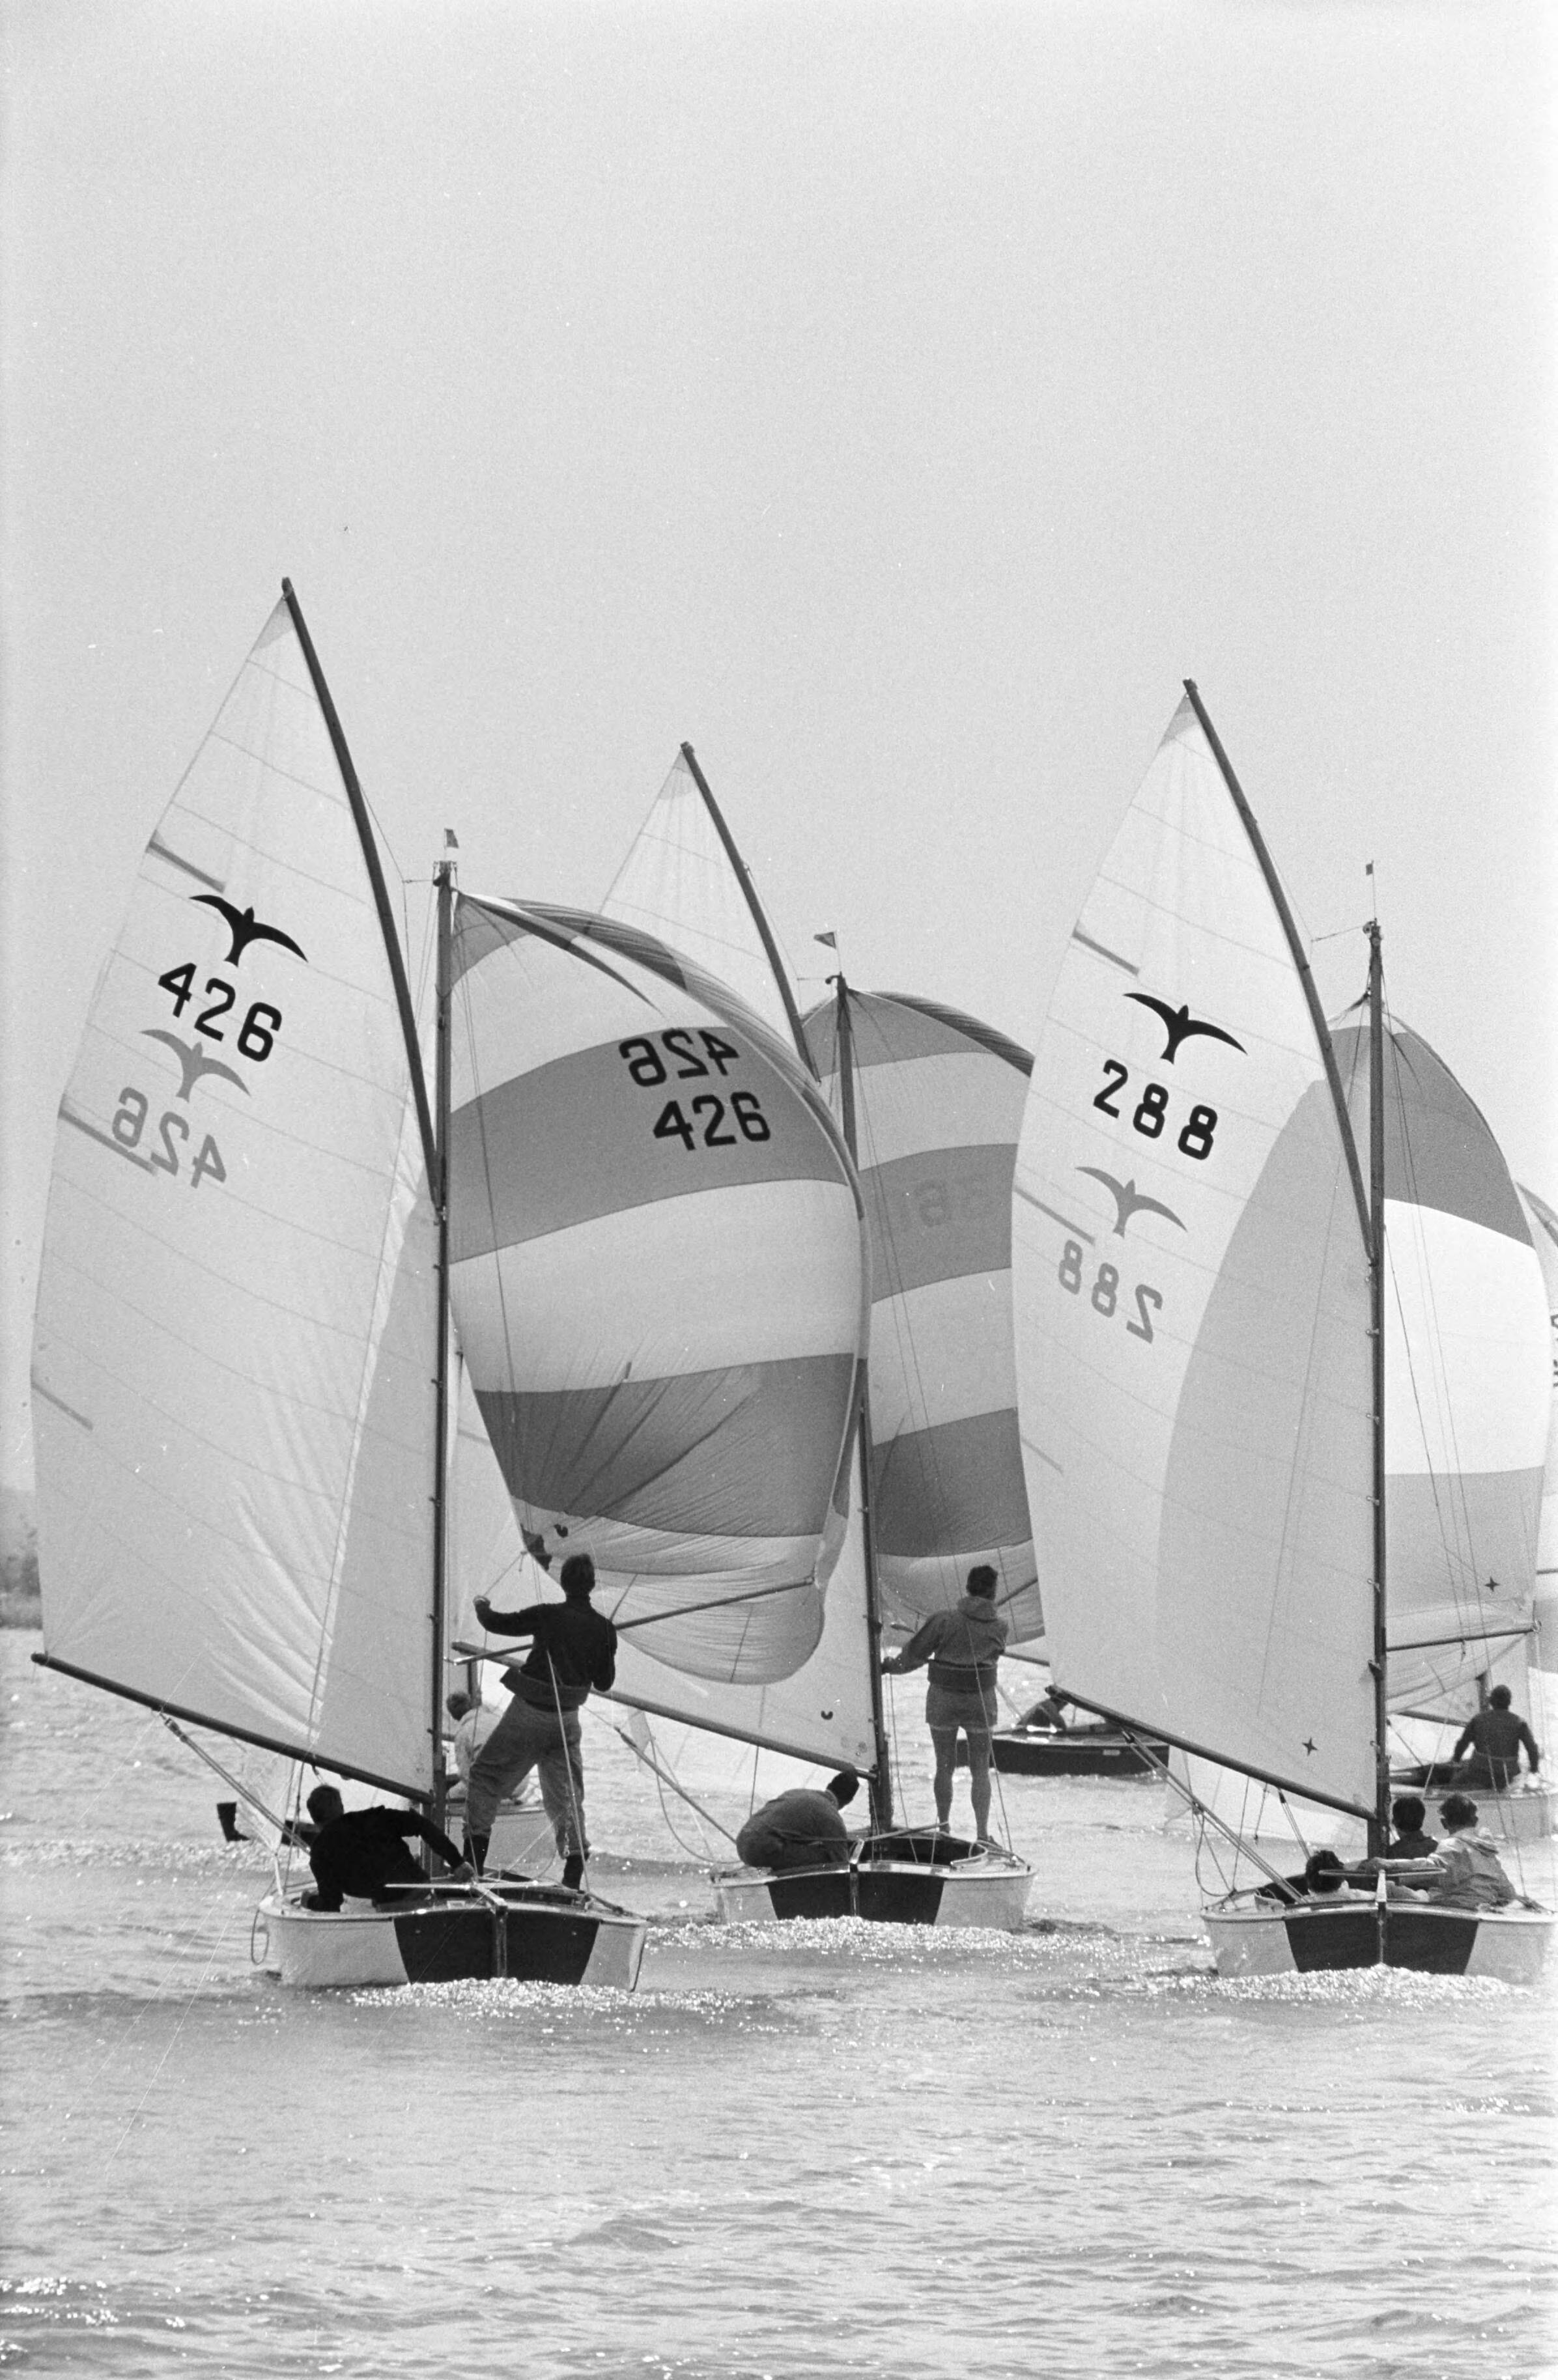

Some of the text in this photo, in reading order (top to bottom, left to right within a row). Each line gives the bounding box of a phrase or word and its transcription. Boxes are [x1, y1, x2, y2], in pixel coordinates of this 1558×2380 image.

[158, 963, 282, 1062] 426
[653, 1091, 771, 1151] 426
[1093, 1059, 1218, 1160] 288
